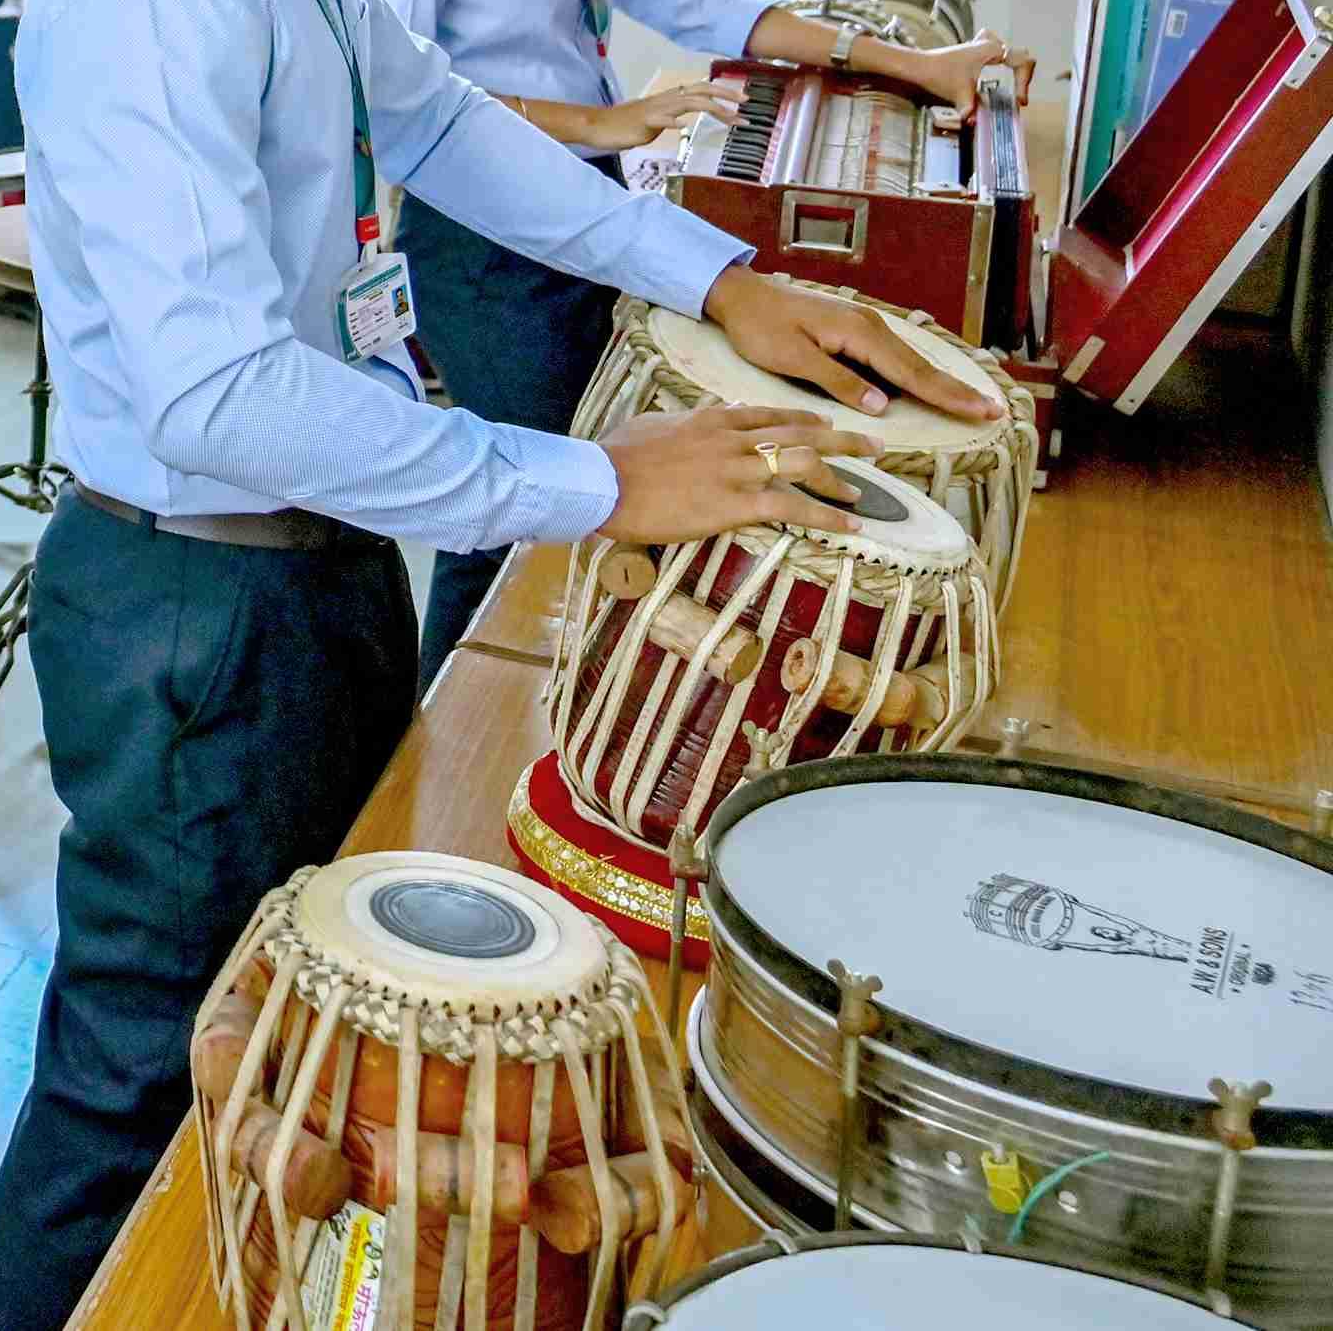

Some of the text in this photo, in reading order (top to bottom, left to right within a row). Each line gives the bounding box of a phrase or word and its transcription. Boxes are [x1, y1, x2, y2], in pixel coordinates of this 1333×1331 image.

[1190, 926, 1228, 995] A.W. & SONS
